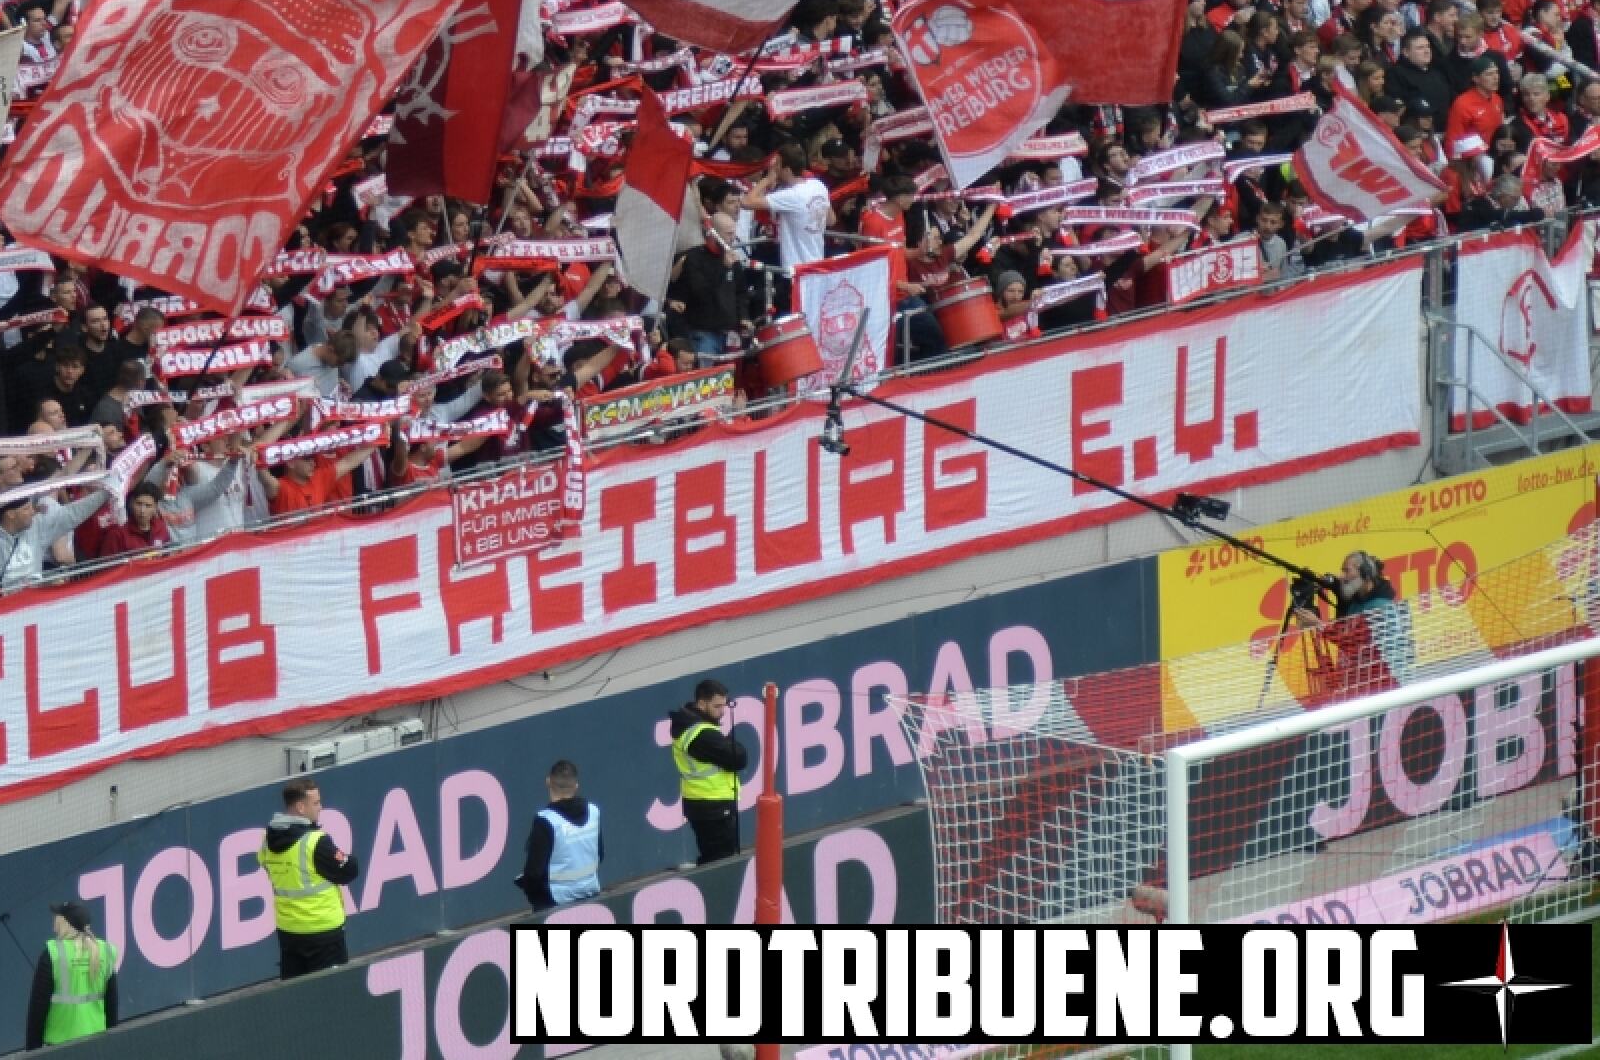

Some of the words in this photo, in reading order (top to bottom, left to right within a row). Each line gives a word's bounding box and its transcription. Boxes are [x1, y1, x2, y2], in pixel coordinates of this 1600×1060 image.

[230, 318, 284, 337] CLUB
[1516, 458, 1596, 492] lotto-bw.de
[461, 471, 559, 515] KHALID
[1428, 479, 1488, 511] LOTTO
[461, 513, 498, 537] FÜR
[507, 523, 550, 545] UNS
[1295, 512, 1372, 548] lotto-bw.de
[1399, 845, 1545, 916] JOBRAD
